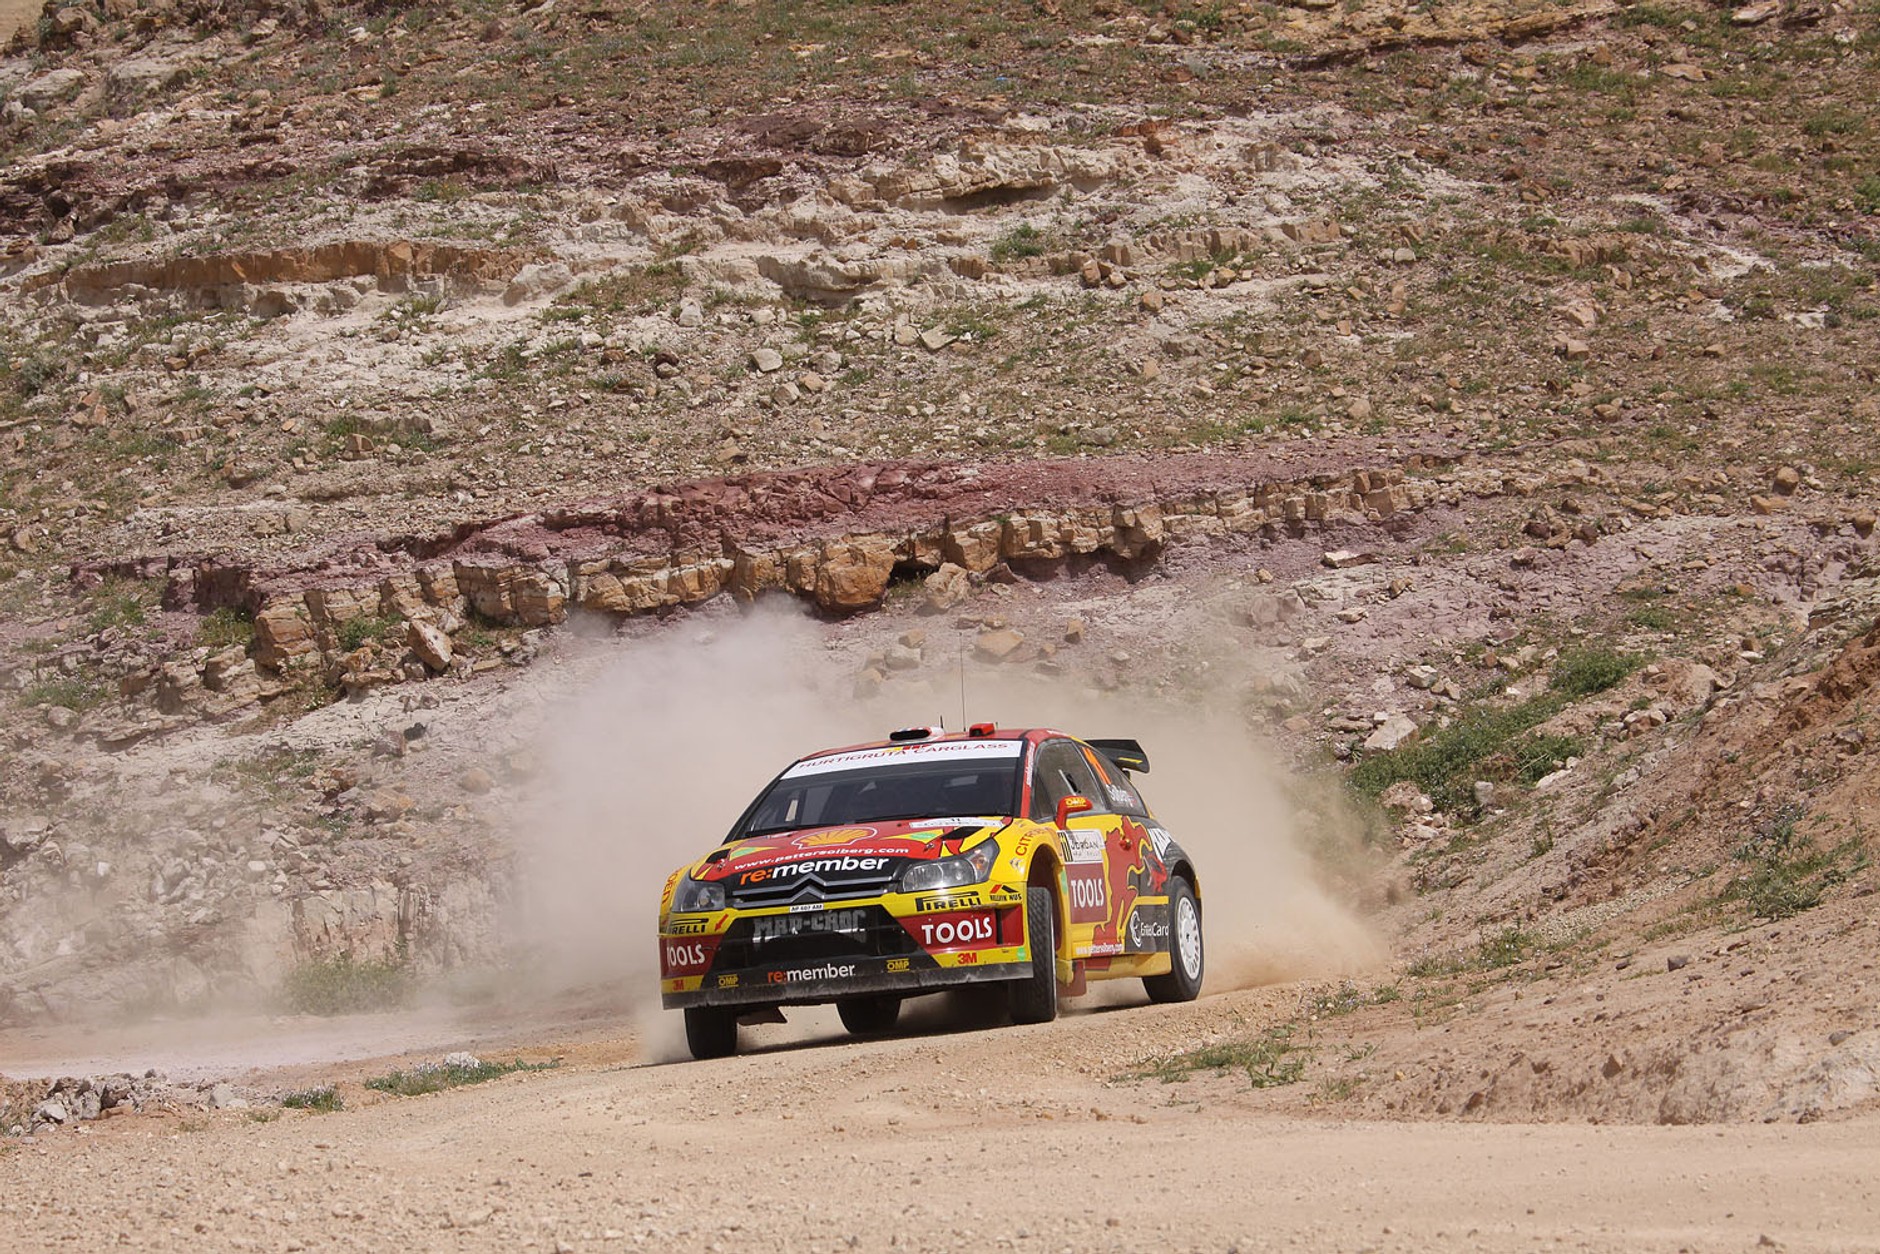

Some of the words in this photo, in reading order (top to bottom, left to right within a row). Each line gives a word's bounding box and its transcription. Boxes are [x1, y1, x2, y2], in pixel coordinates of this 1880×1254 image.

[799, 749, 906, 769] HURTIGRUTA
[914, 743, 1009, 754] CARGLASS
[1065, 798, 1087, 807] OMP
[734, 847, 909, 870] www.pettersolberg.com
[740, 856, 890, 886] re:member
[915, 891, 982, 912] PIRELLI
[1071, 878, 1104, 908] TOOLS
[921, 917, 993, 944] TOOLS
[886, 959, 910, 972] OMP
[957, 952, 978, 964] 3M
[718, 975, 740, 988] OMP
[767, 964, 855, 984] re:member
[672, 979, 685, 991] 3M
